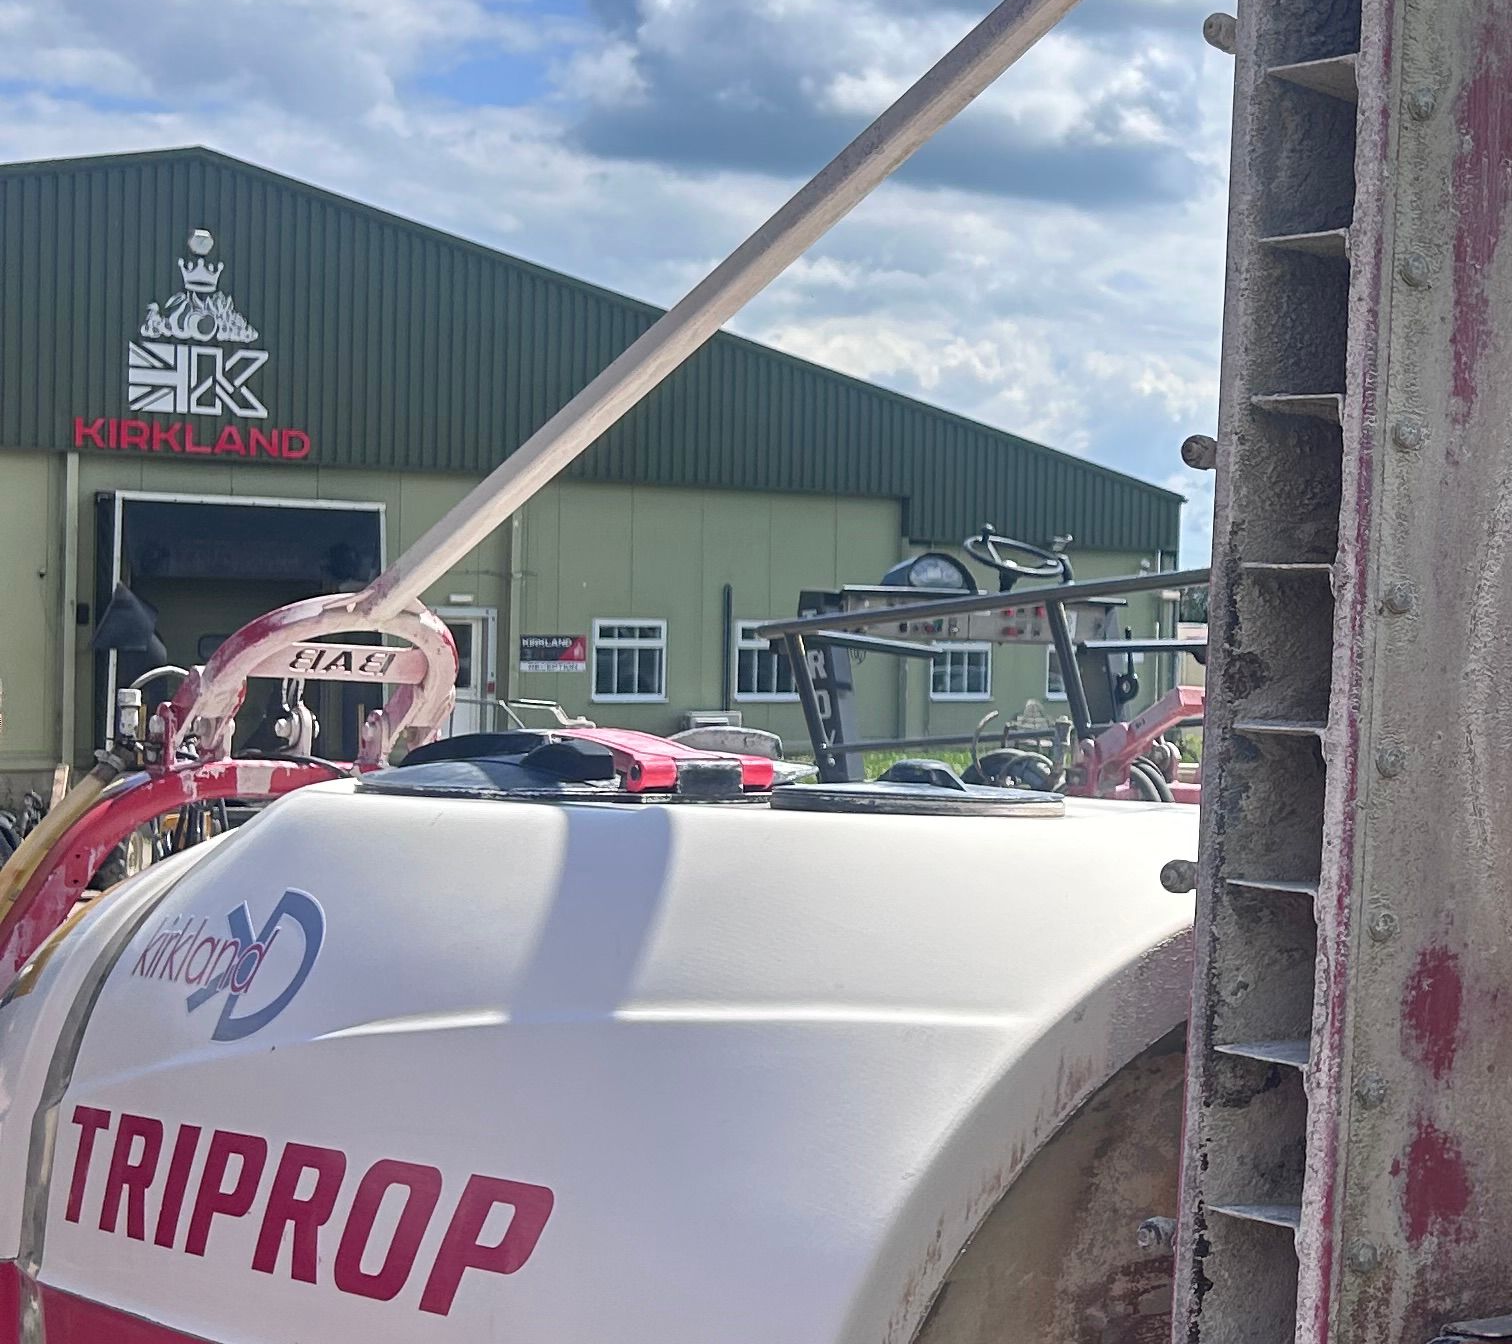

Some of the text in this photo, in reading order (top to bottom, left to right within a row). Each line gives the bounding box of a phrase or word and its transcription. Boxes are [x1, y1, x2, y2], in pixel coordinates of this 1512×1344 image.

[74, 415, 312, 460] KIRKLAND
[131, 914, 282, 995] kirkland
[65, 1104, 555, 1317] TRIPROP
